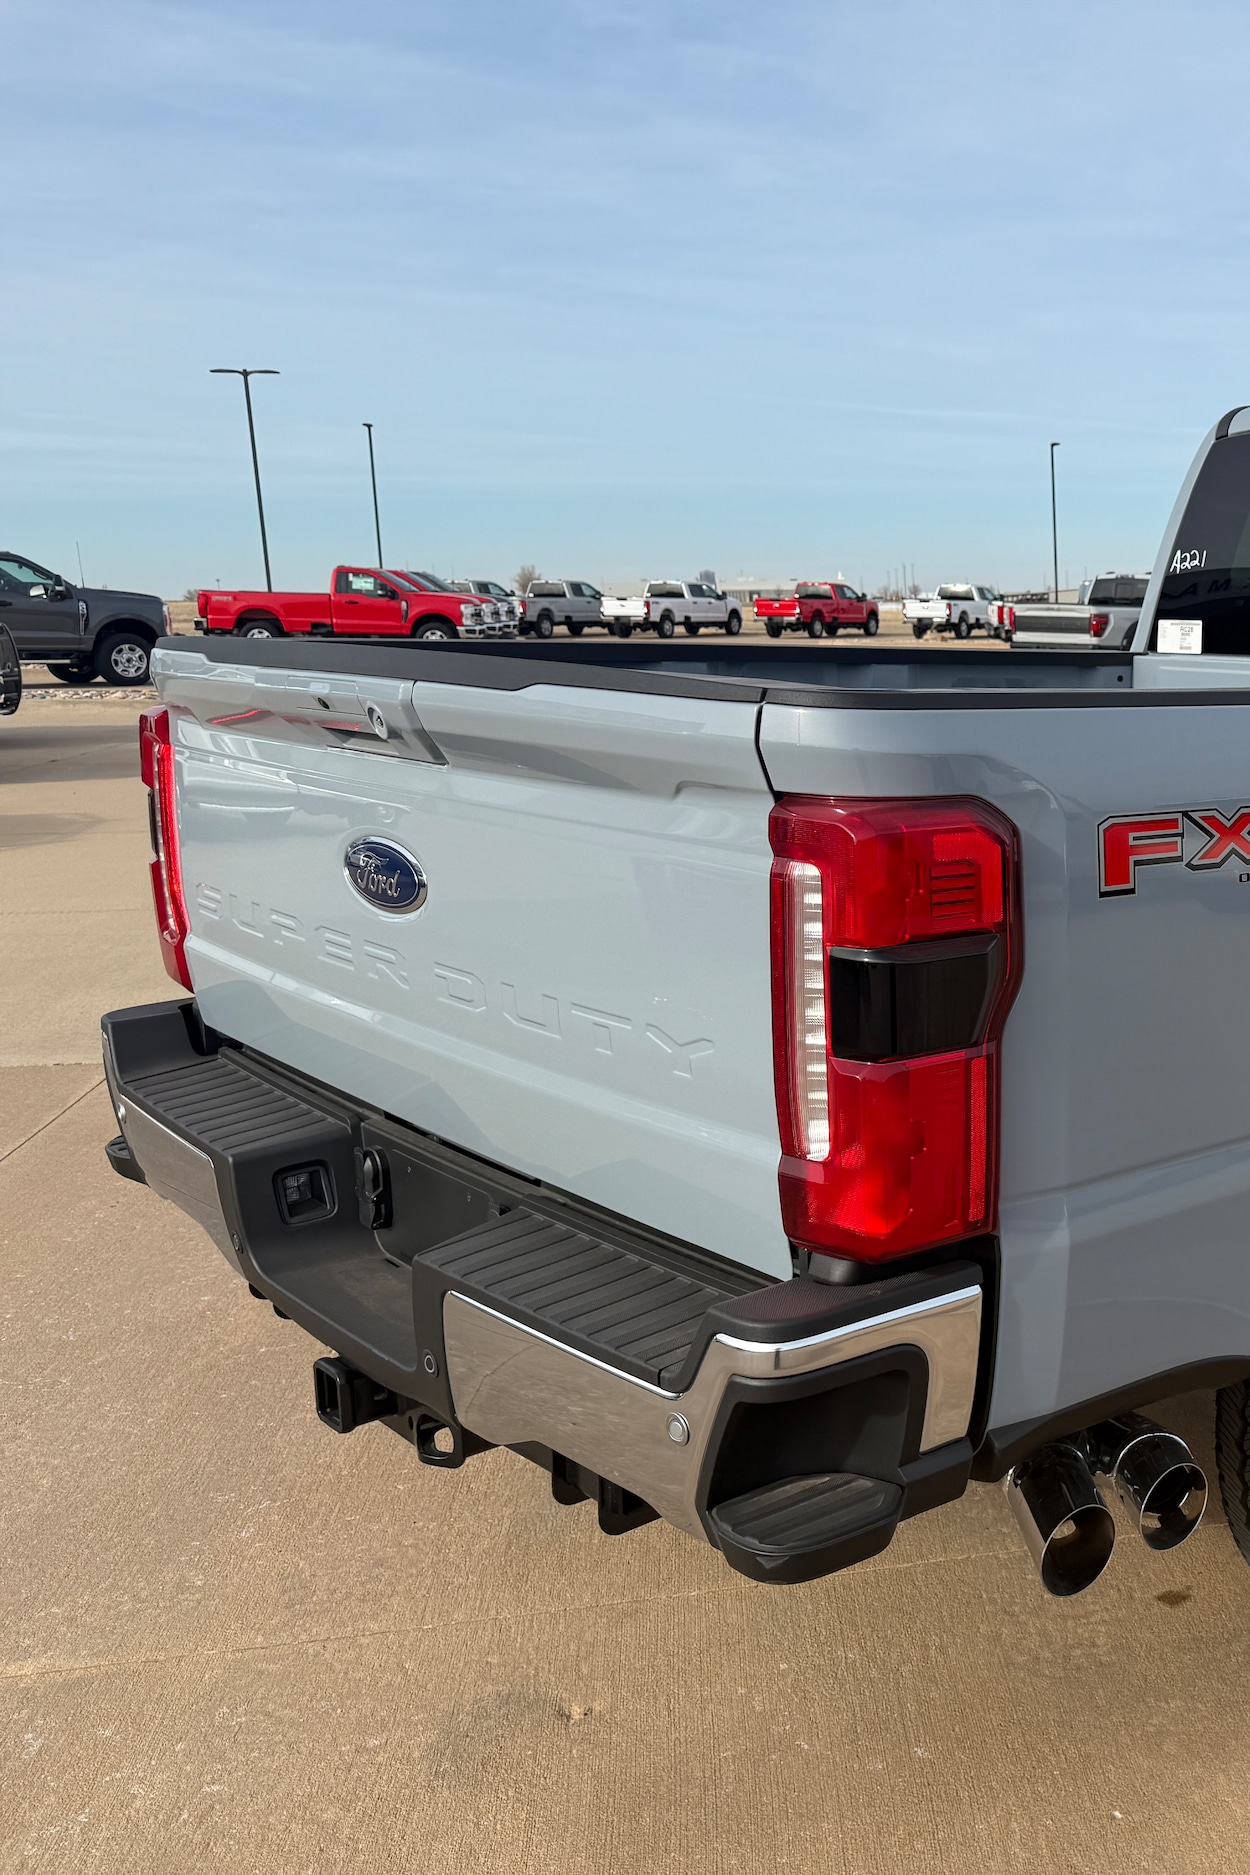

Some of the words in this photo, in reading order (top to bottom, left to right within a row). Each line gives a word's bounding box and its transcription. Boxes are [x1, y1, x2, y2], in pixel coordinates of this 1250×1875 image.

[1169, 549, 1207, 575] A221
[356, 850, 401, 898] Ford
[195, 882, 410, 990] SUPER
[433, 961, 716, 1078] DUTY
